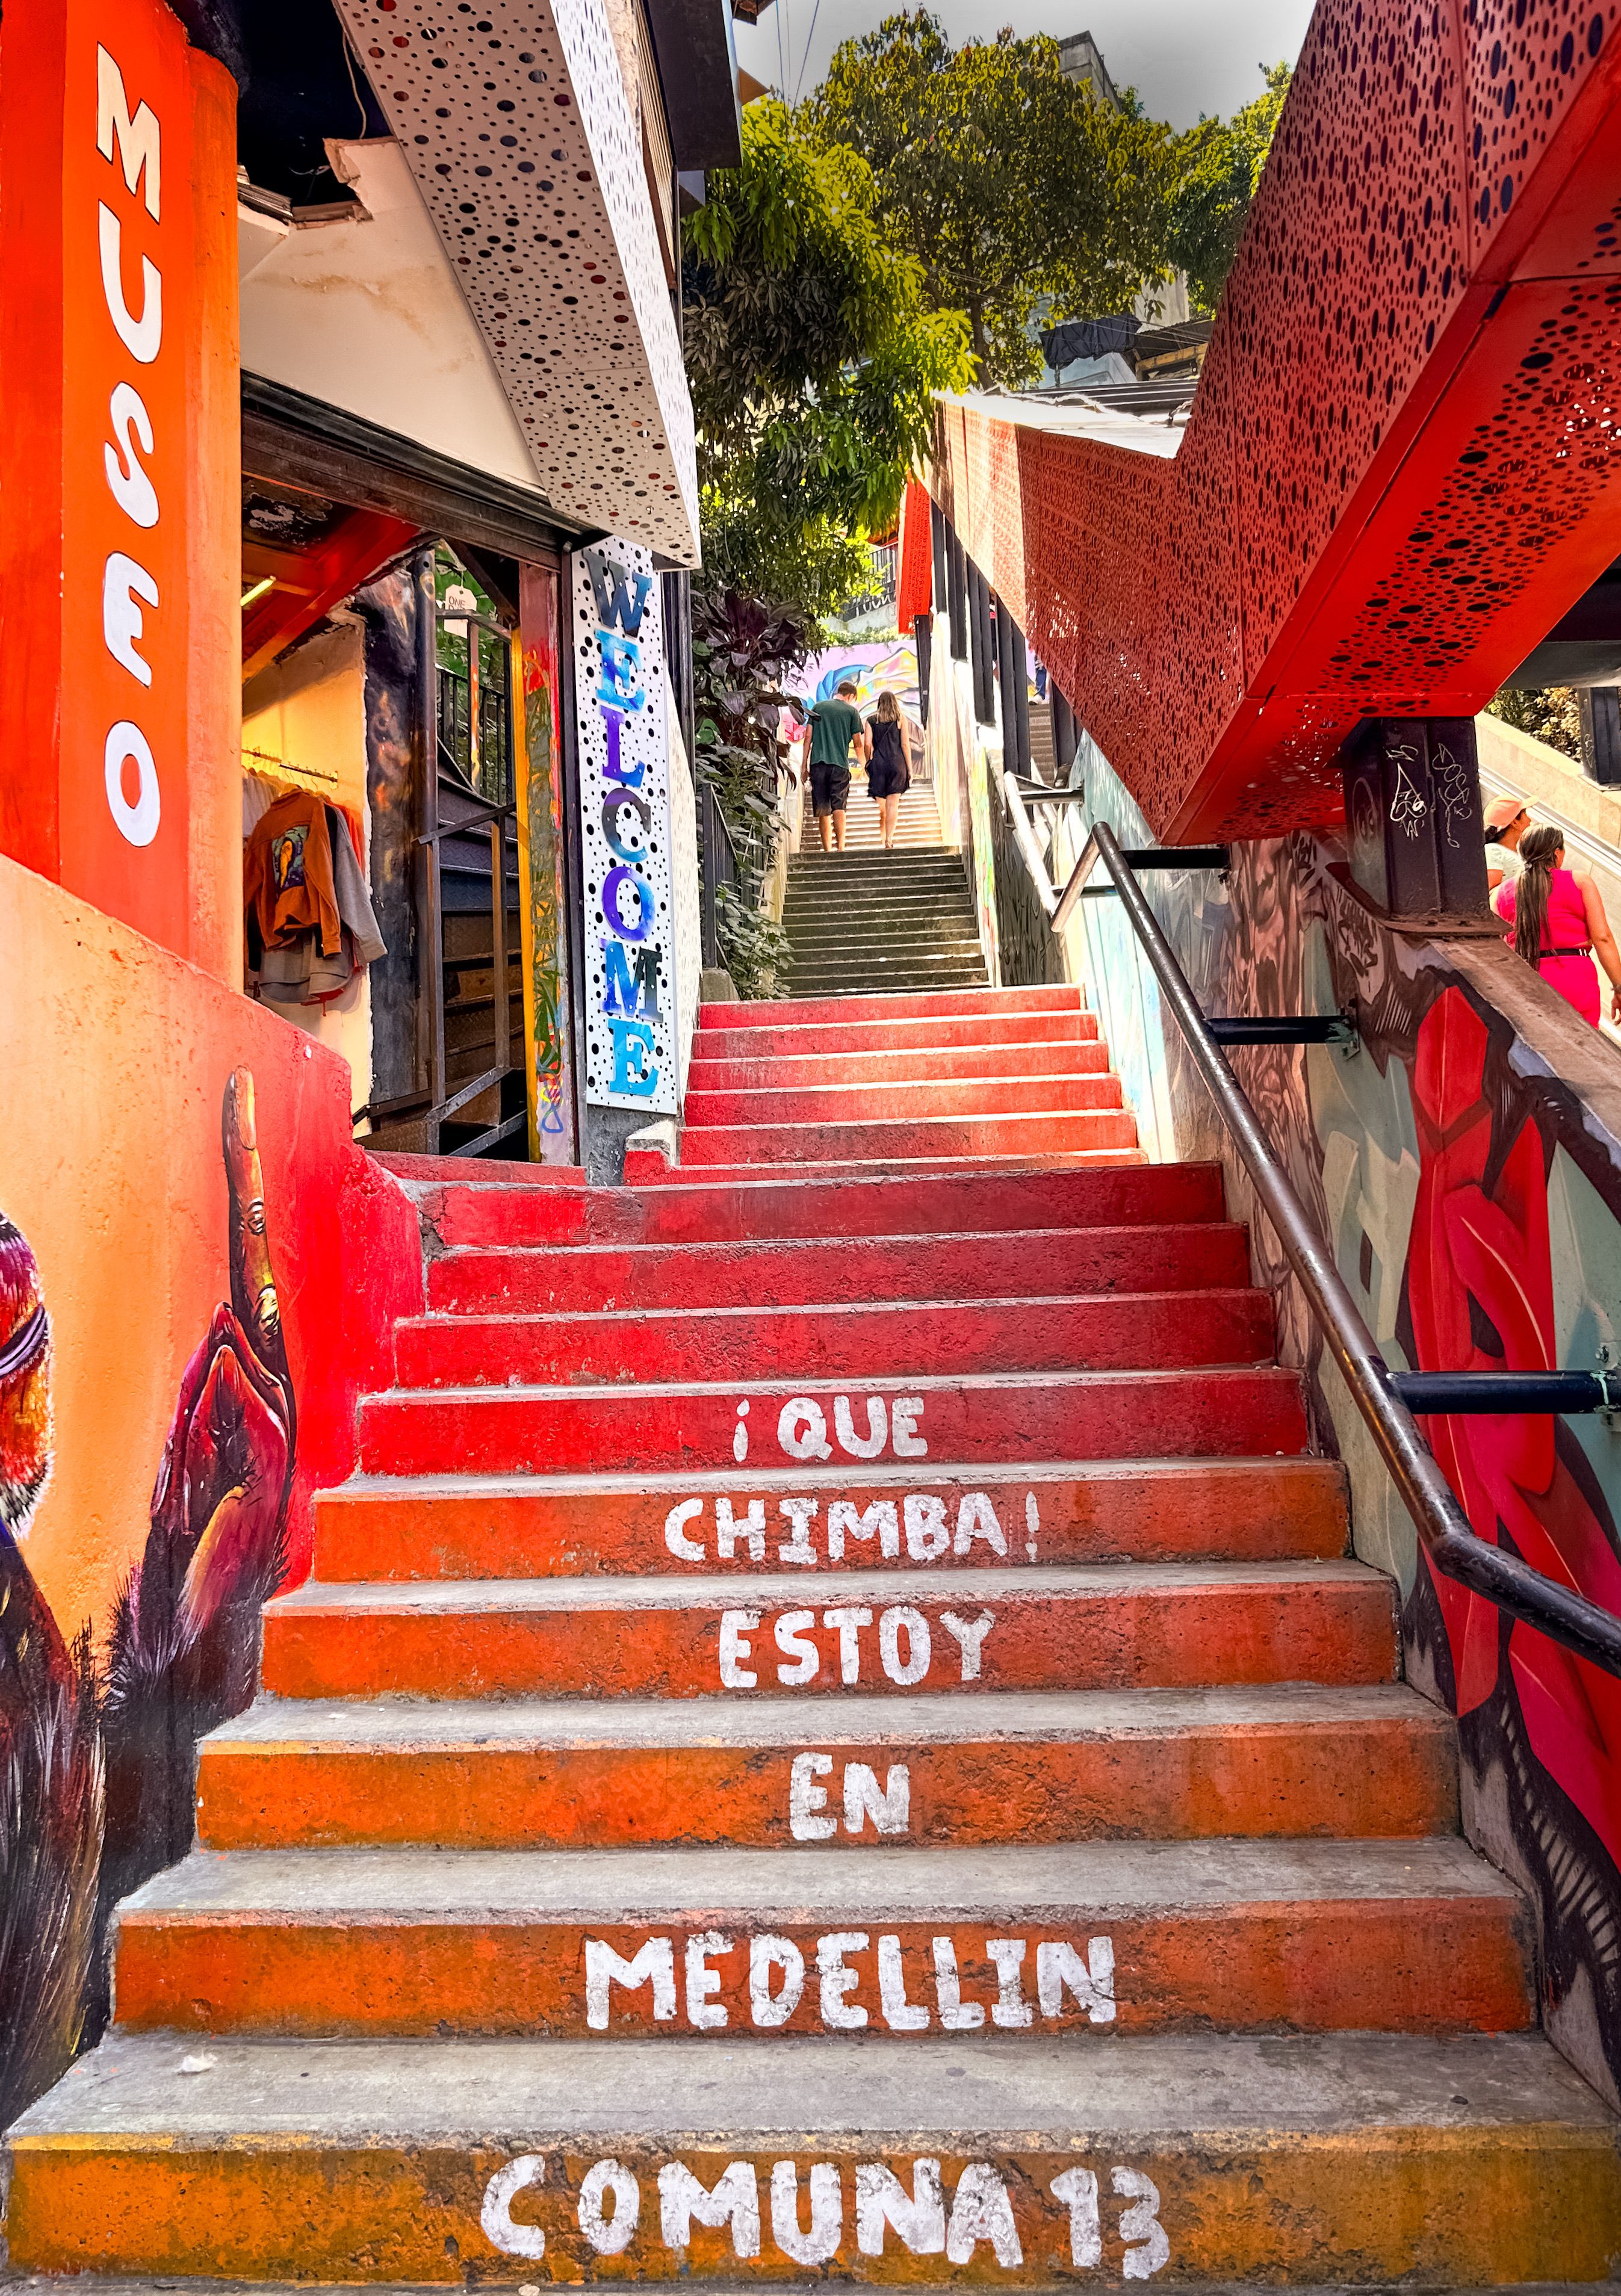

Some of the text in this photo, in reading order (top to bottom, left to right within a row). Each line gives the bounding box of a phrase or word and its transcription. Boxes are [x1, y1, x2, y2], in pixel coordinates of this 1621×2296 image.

[96, 42, 163, 847] MUSEO
[448, 596, 466, 608] ONE
[582, 549, 664, 1097] WELCOME
[718, 1605, 997, 1689] ESTOY
[789, 1751, 911, 1842] EN
[584, 1928, 1118, 2031] MEDELLIN
[480, 2154, 1171, 2280] COMUNA 13
